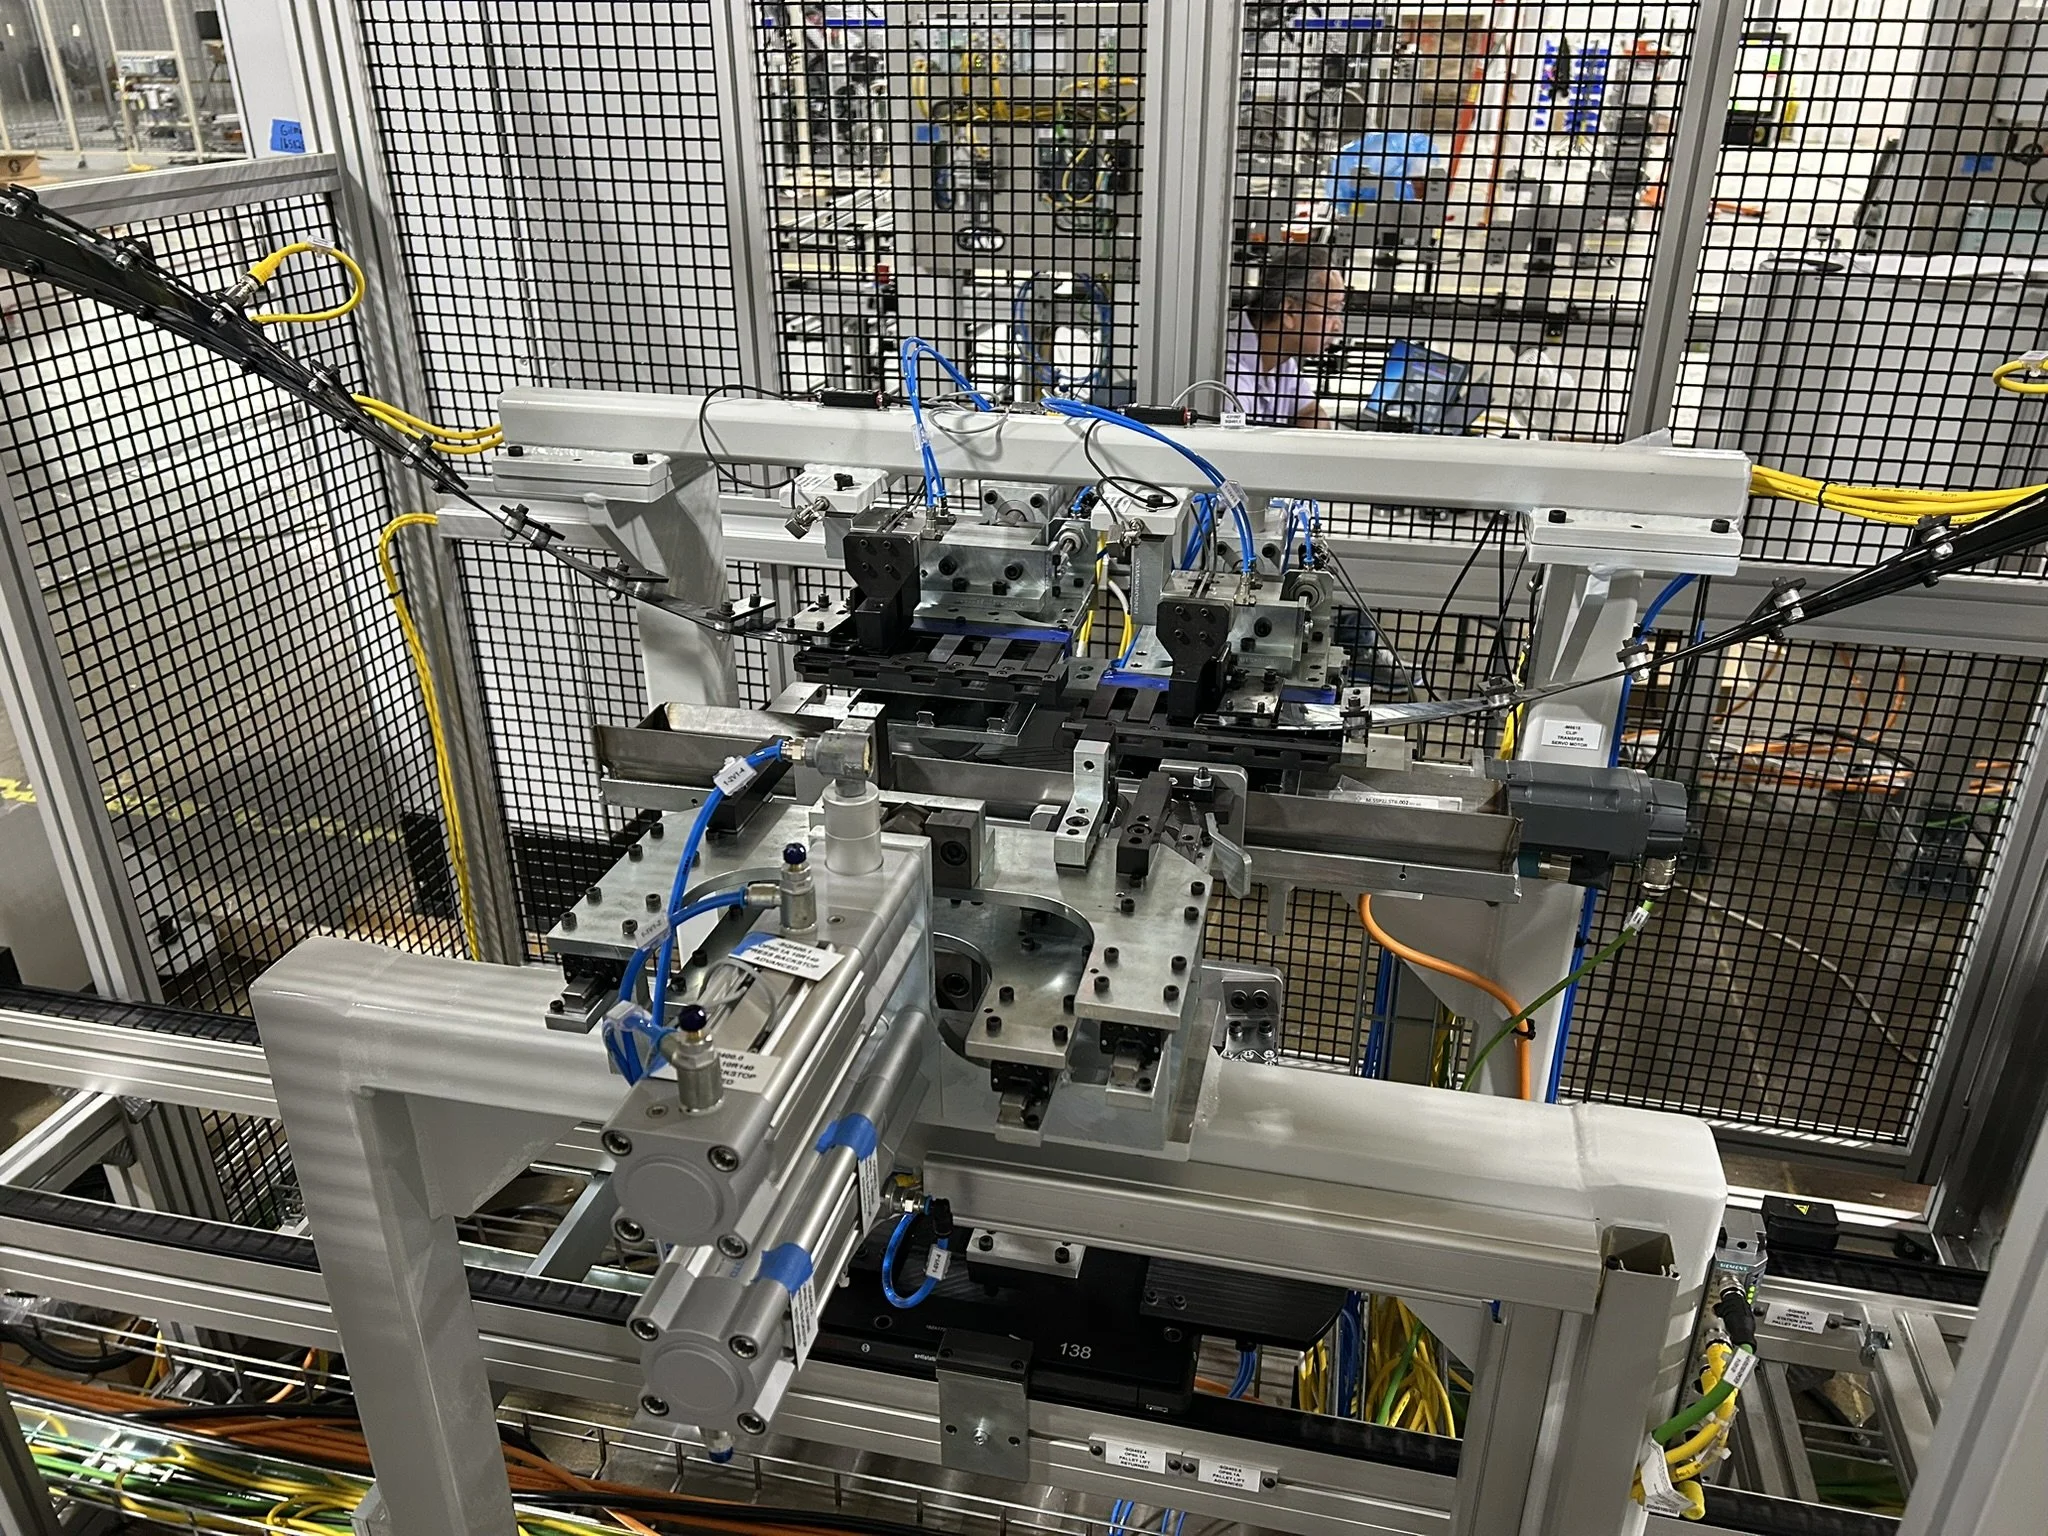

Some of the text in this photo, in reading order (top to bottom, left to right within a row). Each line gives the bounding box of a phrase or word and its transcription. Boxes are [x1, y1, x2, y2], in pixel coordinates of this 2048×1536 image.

[754, 956, 799, 971] ADVANCED
[773, 952, 820, 969] BACKSTOP
[1719, 1262, 1748, 1271] SIEMENS
[1772, 1319, 1792, 1327] PALLET
[1777, 1316, 1799, 1324] STATION
[1059, 1342, 1092, 1359] 138
[1119, 1456, 1139, 1464] PALLET
[1120, 1461, 1149, 1469] RETURNED
[1212, 1473, 1233, 1481] PALLET
[1213, 1479, 1243, 1488] ADVANCED
